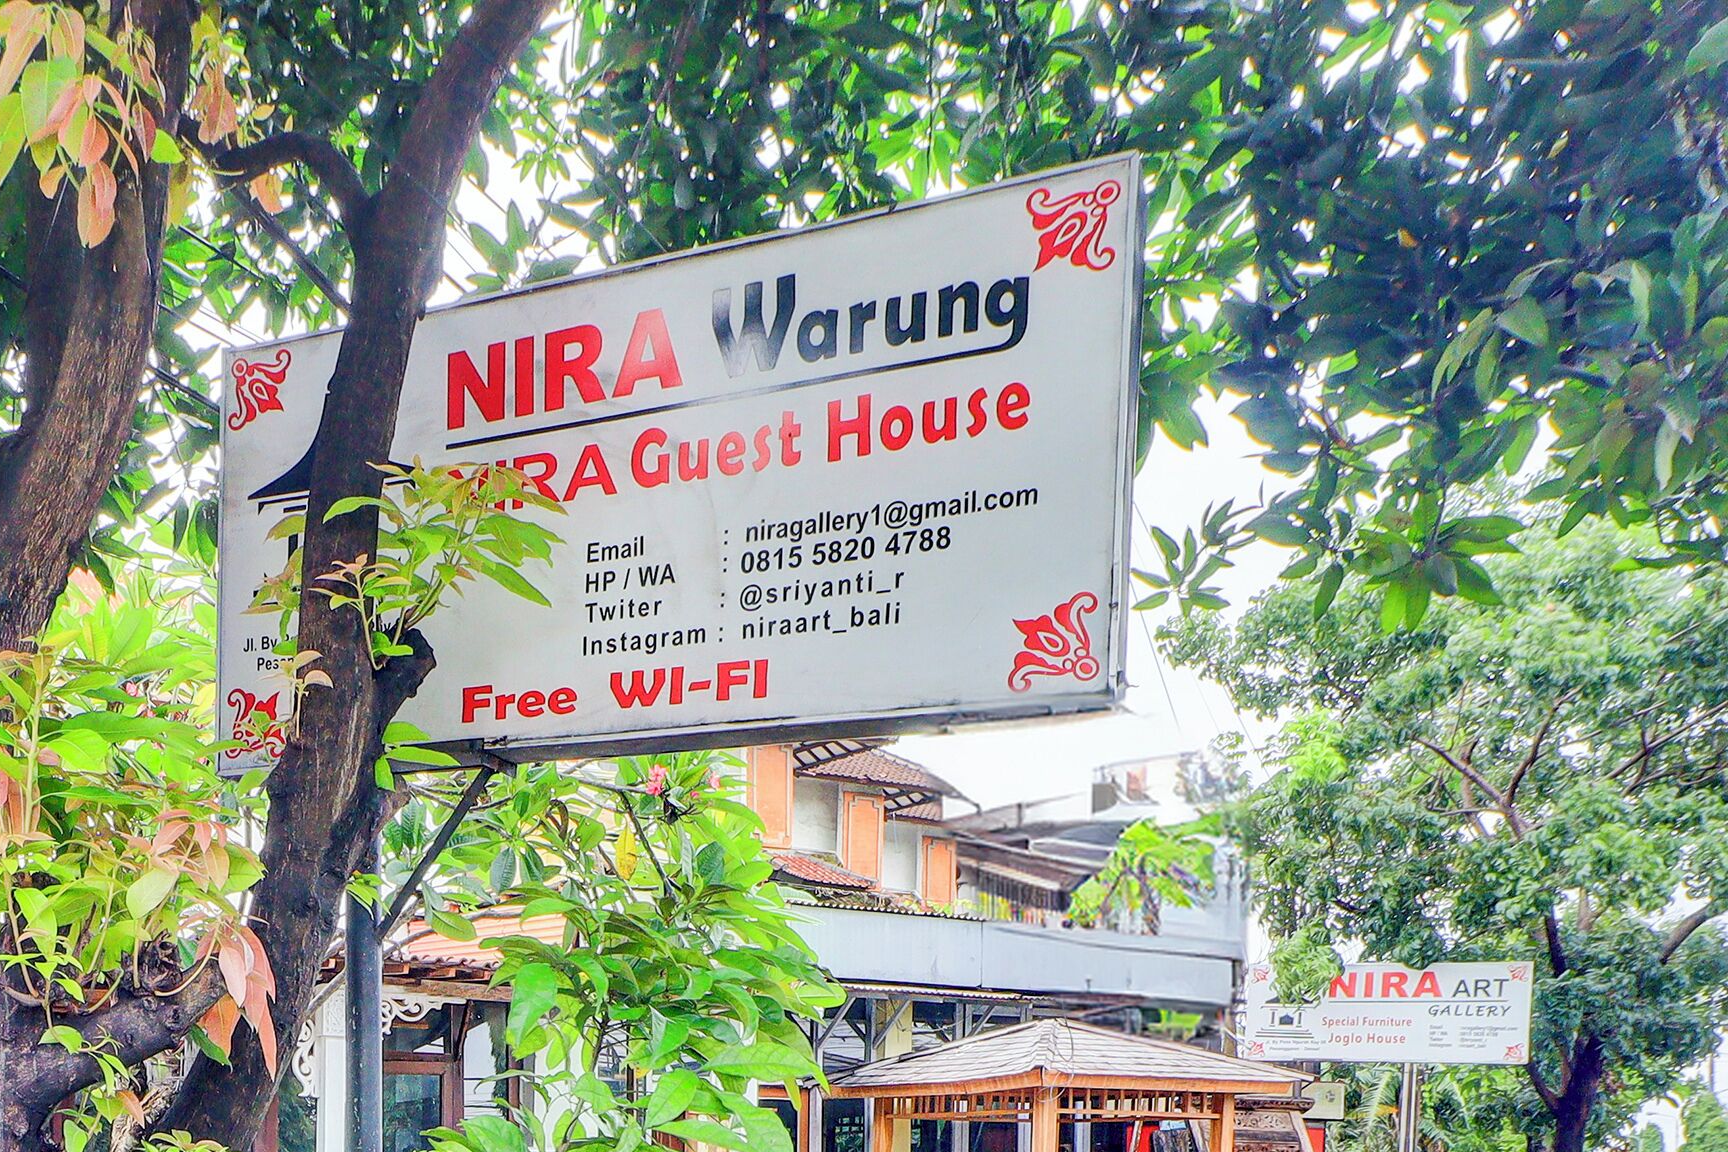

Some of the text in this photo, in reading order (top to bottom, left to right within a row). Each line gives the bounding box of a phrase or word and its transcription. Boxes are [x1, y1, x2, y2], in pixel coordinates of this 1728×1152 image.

[447, 273, 1031, 430] NIRA Warung
[630, 410, 802, 489] Guest
[826, 382, 1031, 463] House
[586, 535, 645, 563] Email
[745, 487, 1039, 543] niragallery1@gmail.com
[585, 570, 616, 594] HP
[638, 563, 676, 587] WA
[740, 545, 803, 574] 0815
[811, 536, 876, 566] 5820
[884, 526, 952, 556] 4788
[584, 598, 663, 624] Twiter
[739, 570, 905, 612] @sriyanti_r
[582, 626, 707, 657] Instagram
[741, 602, 901, 640] niraart_bali
[461, 659, 770, 724] Free WI-FI
[1328, 971, 1510, 998] NIRA ART
[1427, 1004, 1512, 1018] GALLERY
[1321, 1016, 1413, 1028] Special Furniture
[1327, 1033, 1363, 1047] Joglo
[1365, 1033, 1407, 1045] House
